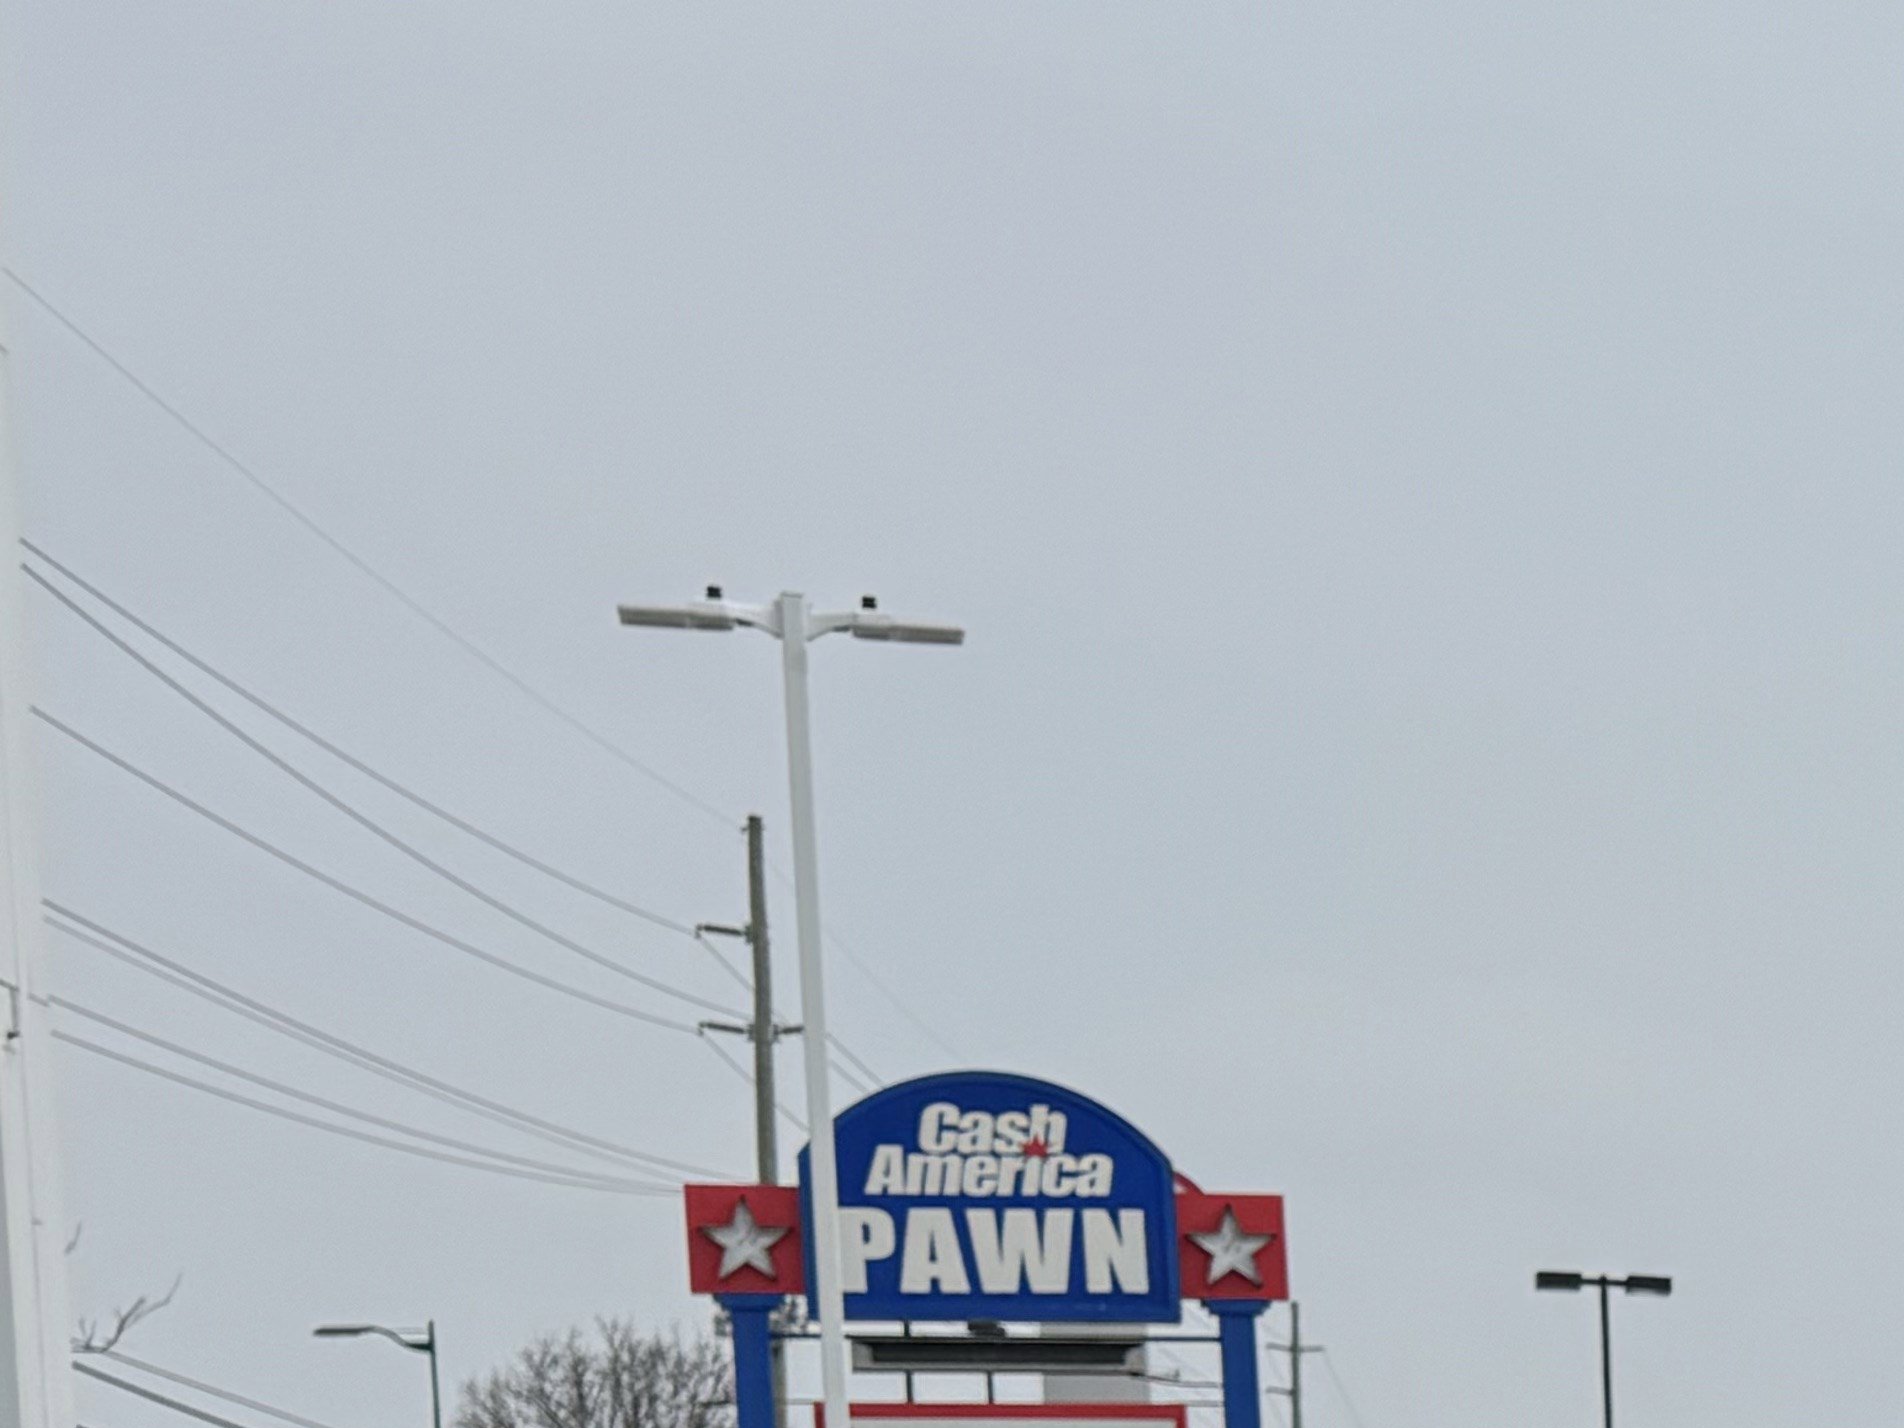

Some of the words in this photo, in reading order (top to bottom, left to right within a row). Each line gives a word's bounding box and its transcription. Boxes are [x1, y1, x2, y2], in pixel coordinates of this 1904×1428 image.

[918, 1102, 1068, 1155] Cash
[864, 1144, 1114, 1197] America
[838, 1206, 1150, 1295] PAWN
